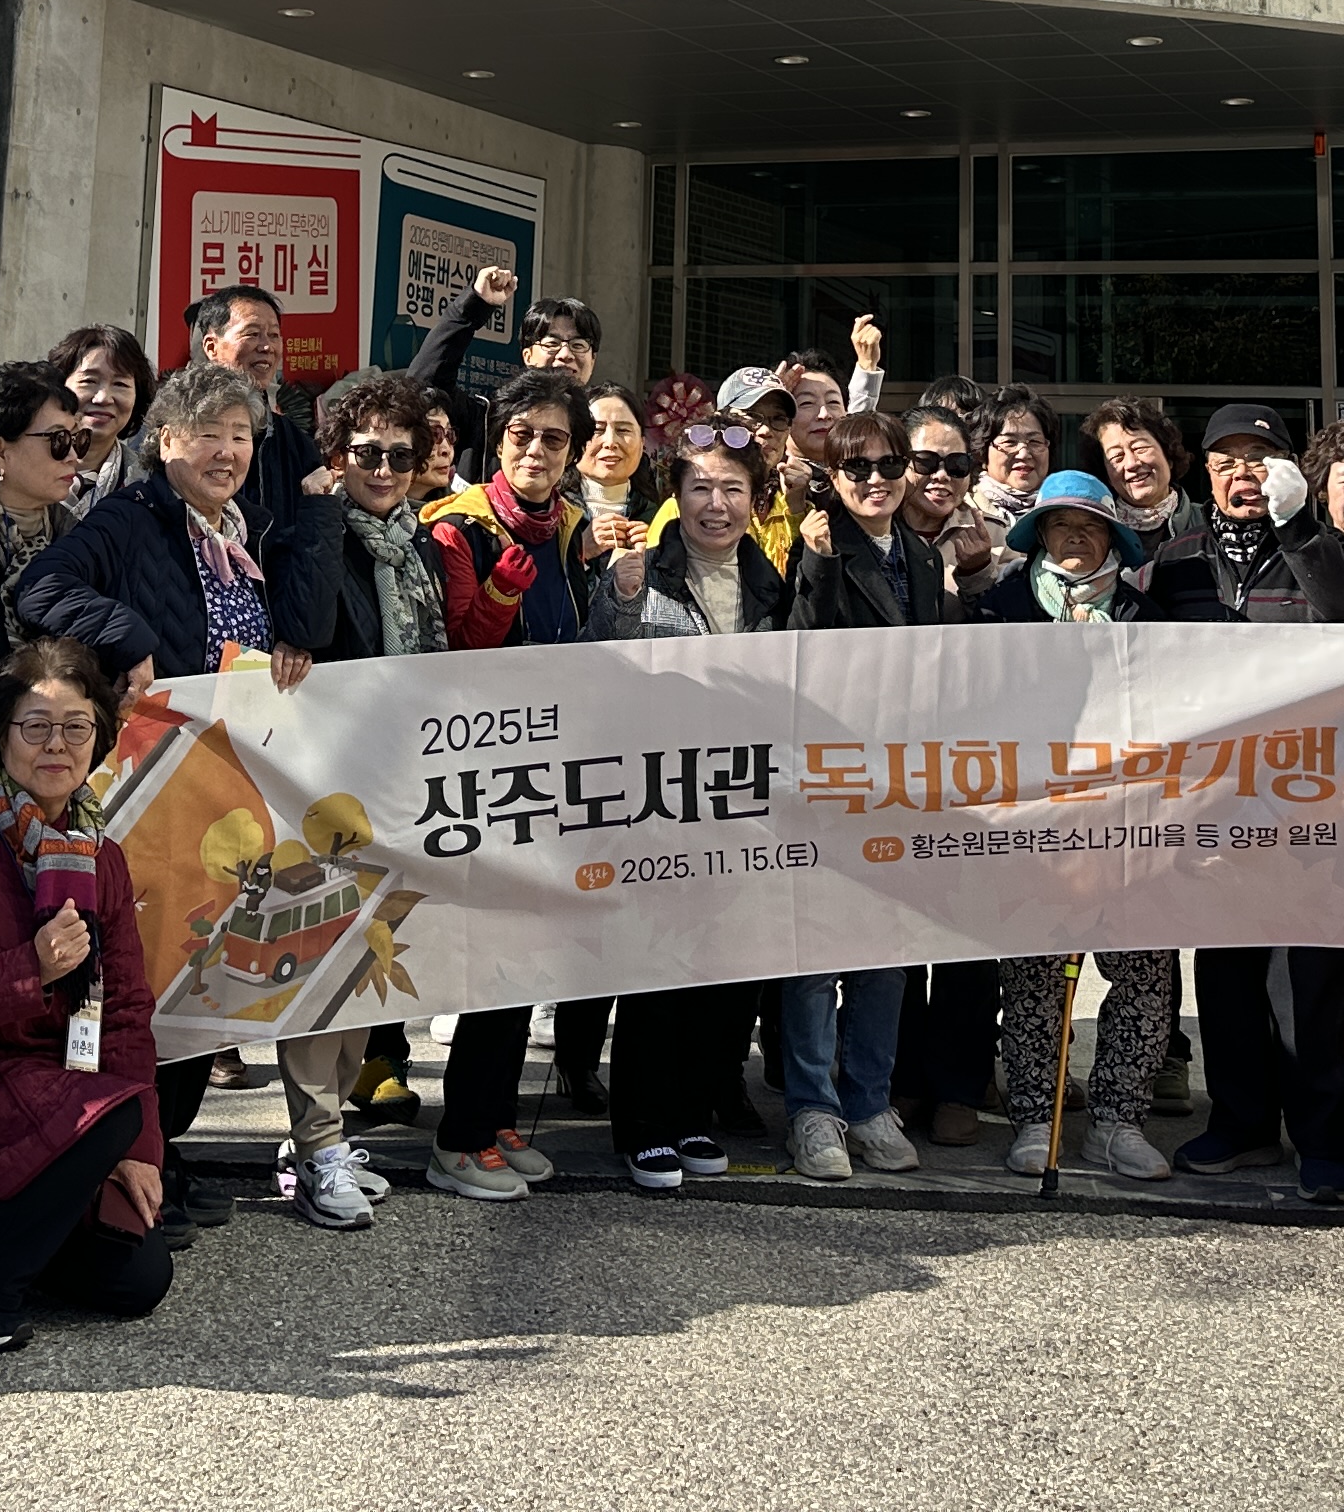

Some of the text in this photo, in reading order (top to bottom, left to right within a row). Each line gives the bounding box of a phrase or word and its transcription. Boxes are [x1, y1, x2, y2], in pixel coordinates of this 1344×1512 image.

[200, 210, 330, 238] 소나기마을 온라인 문학강의
[200, 241, 329, 296] 문학마실
[406, 282, 434, 318] 양평
[324, 354, 339, 370] 검색
[420, 704, 560, 756] 2025년
[414, 725, 1339, 858] 상주도서관 독서회 문학기행
[620, 854, 696, 885] 2025.
[704, 850, 733, 876] 11.
[743, 841, 819, 873] 15.(토)
[910, 824, 1188, 859] 황순원문학촌소나기마을
[1195, 824, 1221, 849] 등
[1229, 825, 1280, 850] 양평
[1288, 823, 1339, 848] 일원
